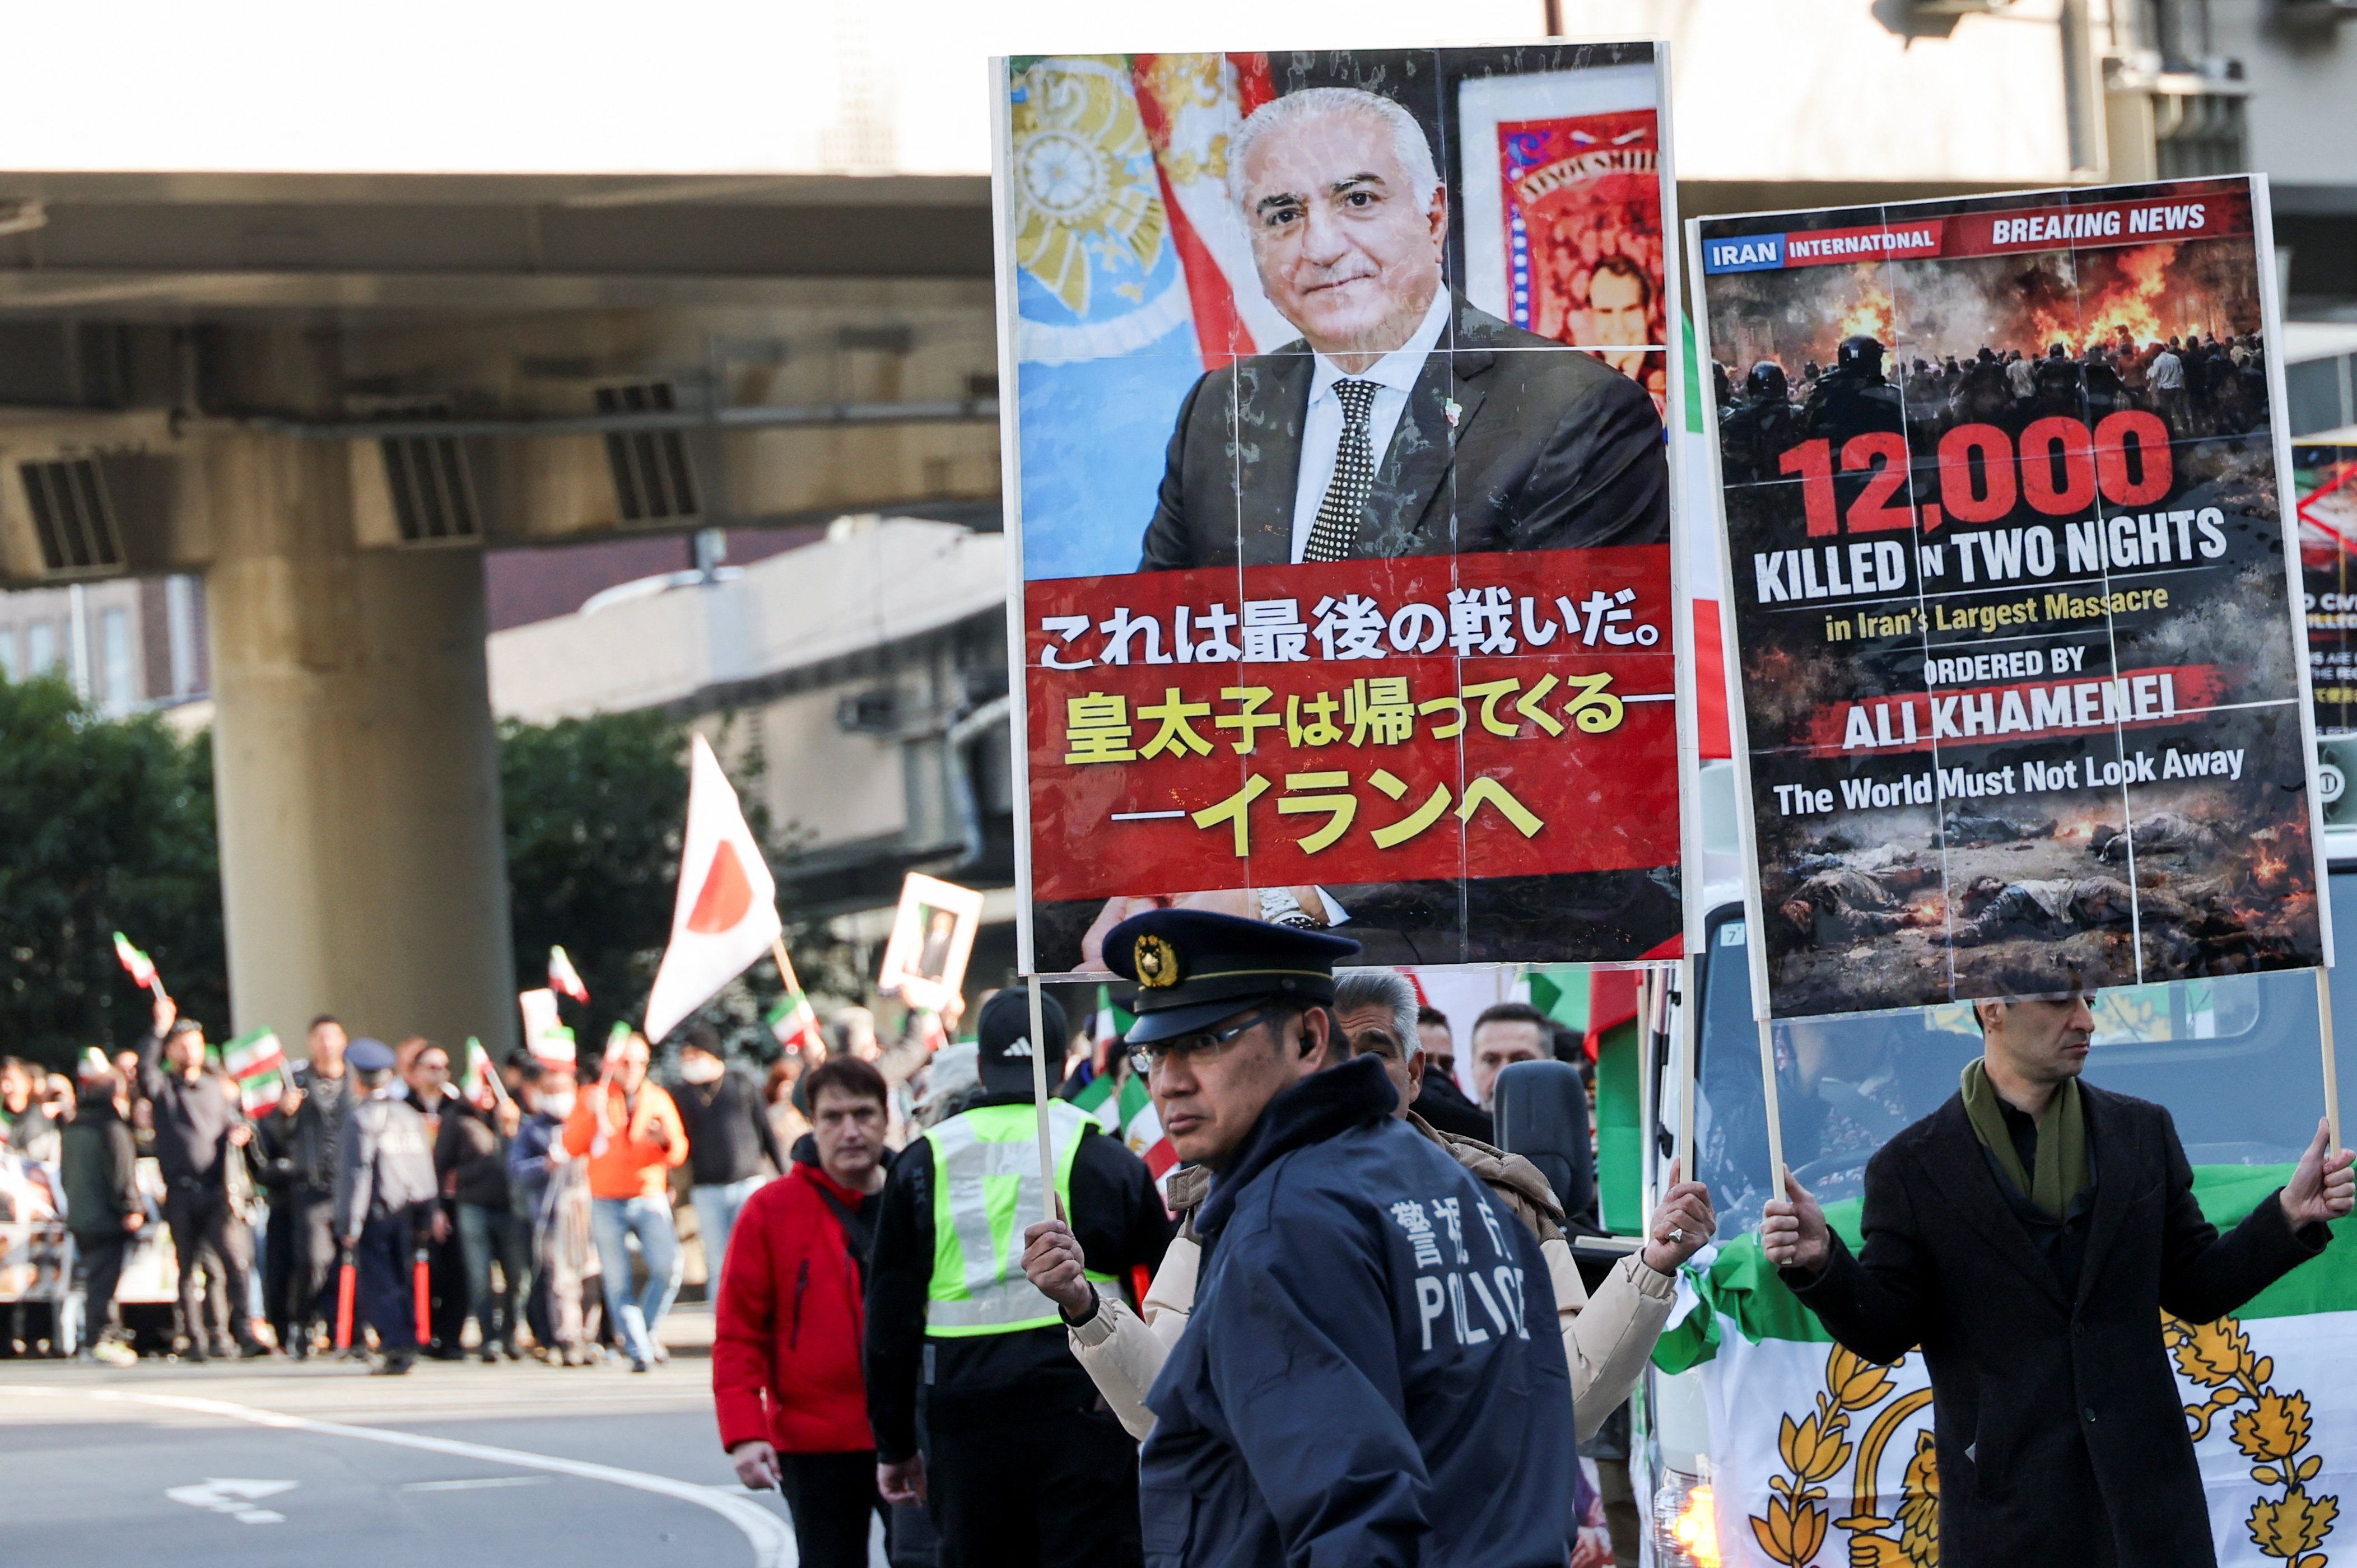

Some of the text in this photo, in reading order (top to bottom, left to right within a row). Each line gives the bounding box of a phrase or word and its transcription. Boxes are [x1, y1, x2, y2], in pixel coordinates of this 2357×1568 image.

[1712, 241, 1778, 267] IRAN
[1993, 204, 2205, 244] BREAKING NEWS
[1778, 410, 2173, 538] 12,000
[1754, 540, 1906, 603] KILLED
[1950, 525, 2055, 583] TWO
[2065, 507, 2227, 574] NIGHTS
[1041, 587, 1659, 670] これは最後の戦いだ。
[1826, 613, 1852, 641] in
[1935, 597, 2038, 633] Largest
[2045, 586, 2168, 620] Massacre
[1923, 646, 2085, 685] ORDERED BY
[1842, 674, 2176, 750] ALI KHAMENEI
[1773, 748, 2245, 816] The World Must Not Look Away
[1728, 931, 1736, 942] 7
